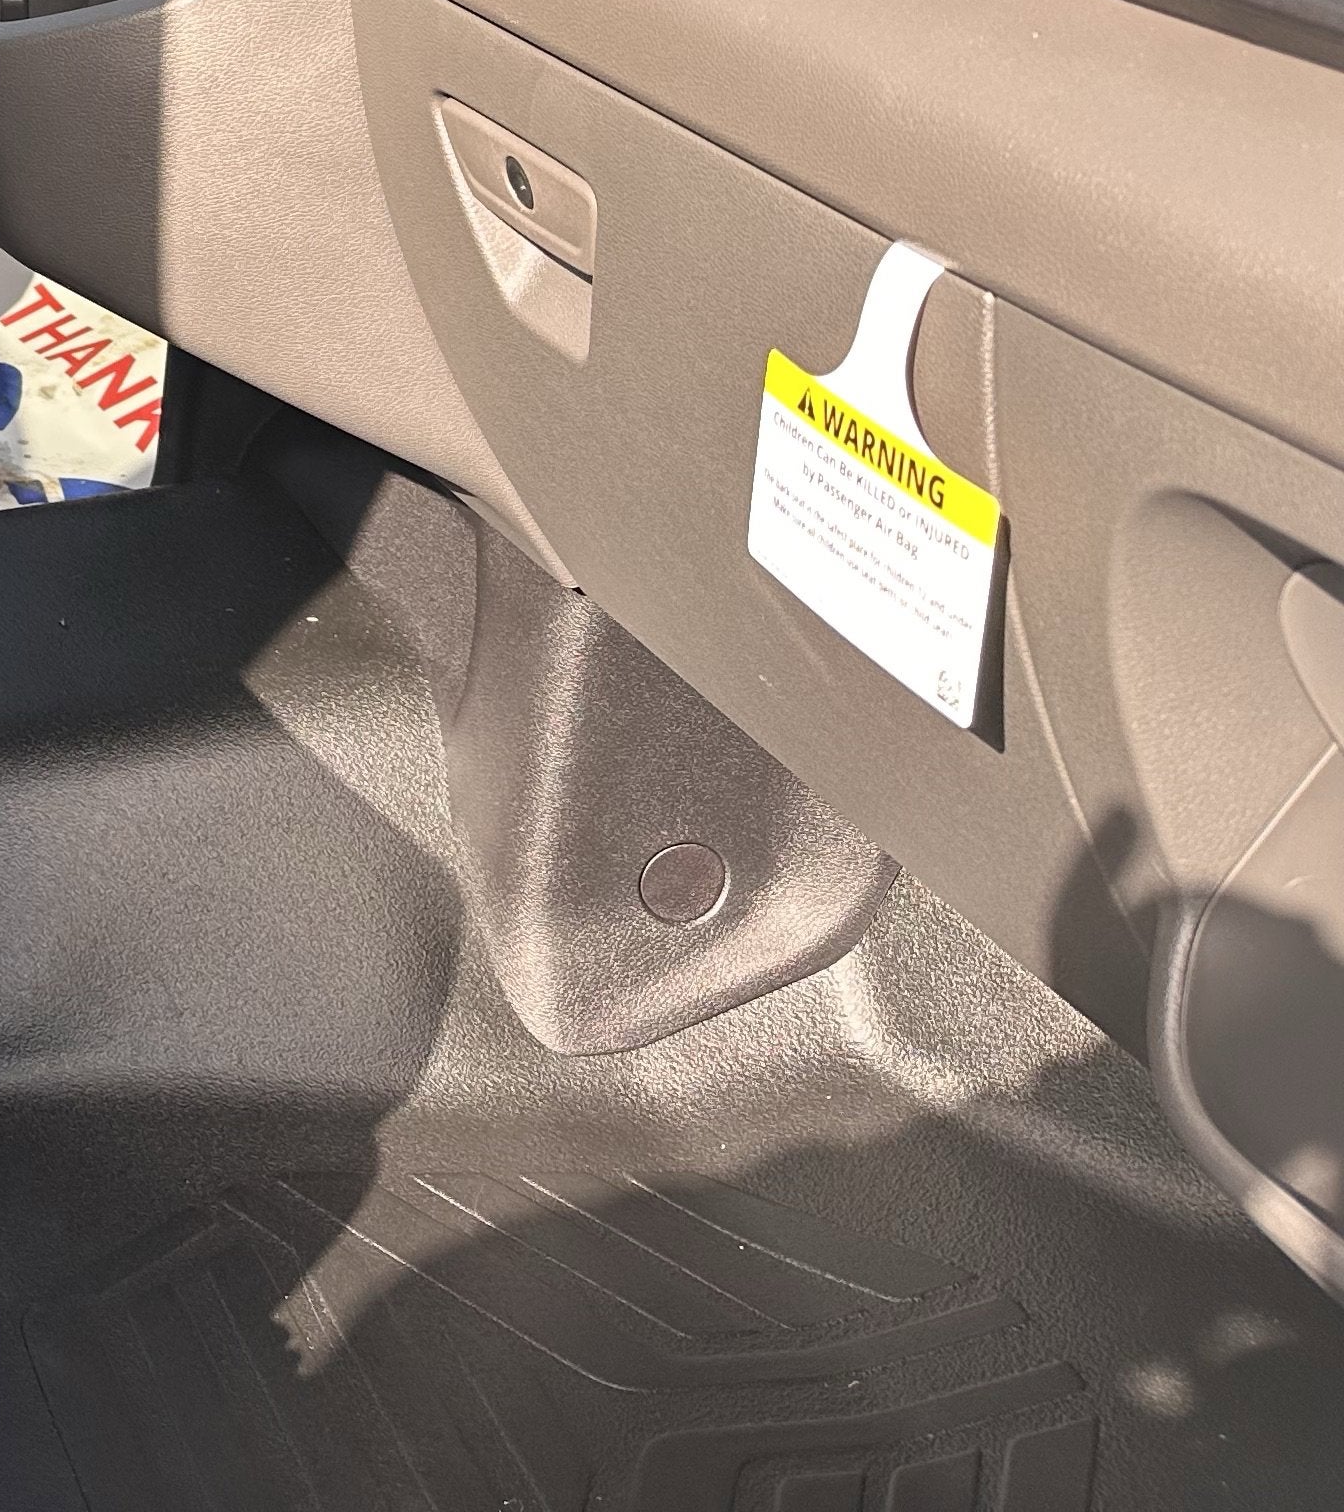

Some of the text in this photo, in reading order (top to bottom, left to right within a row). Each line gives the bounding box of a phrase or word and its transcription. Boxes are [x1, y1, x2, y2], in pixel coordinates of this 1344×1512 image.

[0, 282, 163, 454] THANK
[772, 409, 970, 567] Children Can Be KILLED or INJURED
[801, 460, 919, 561] by Passenger Air Bag
[823, 399, 945, 509] WARNING
